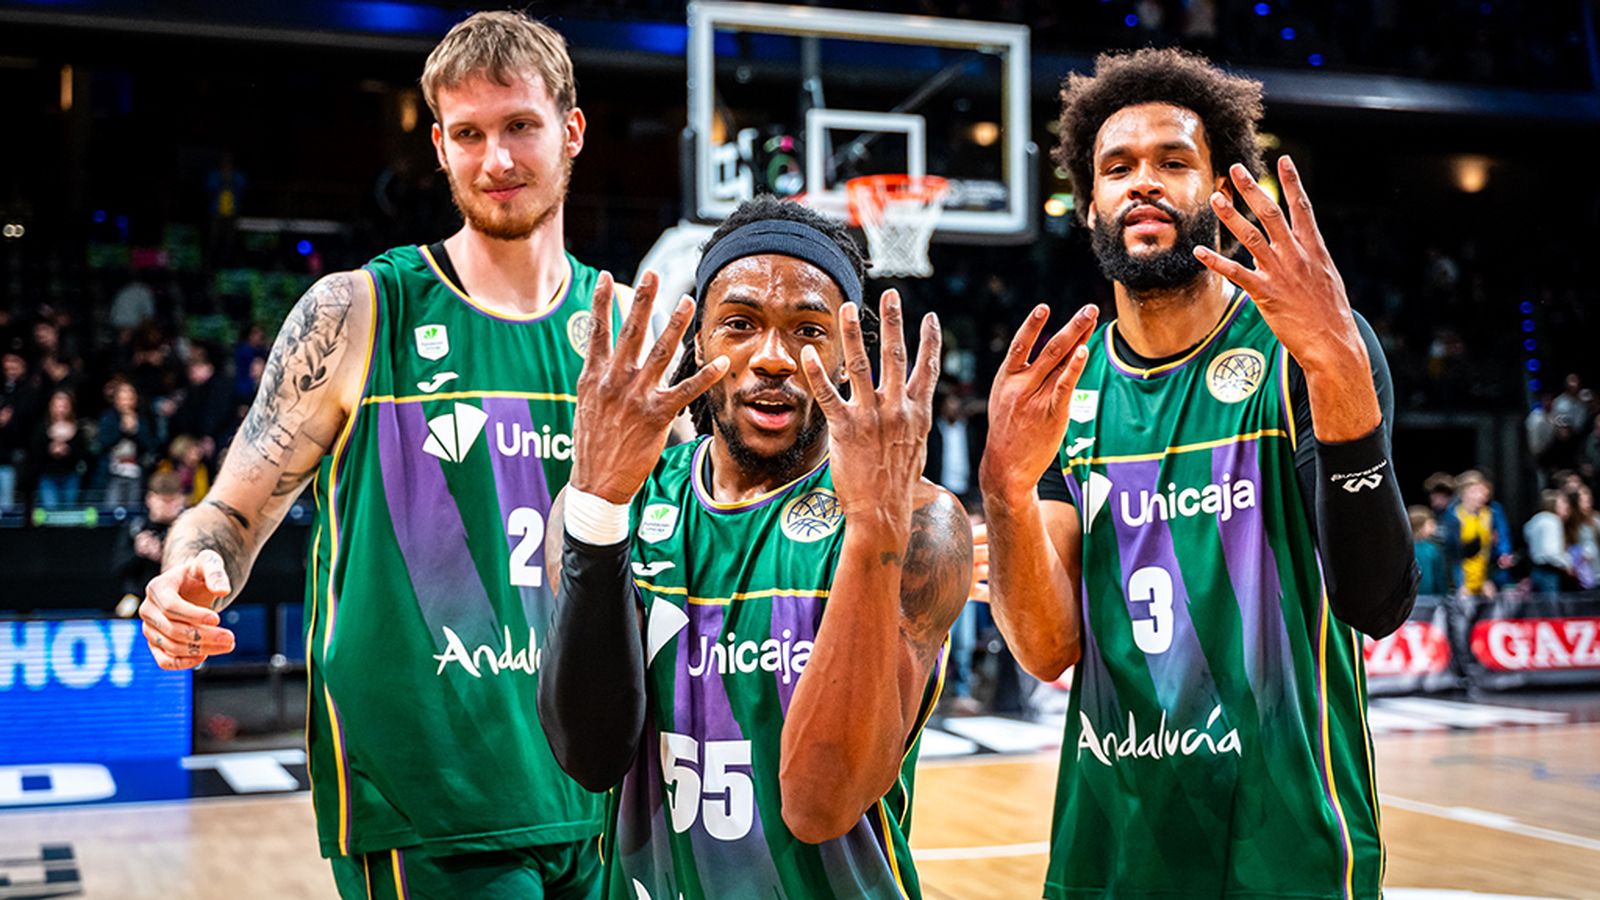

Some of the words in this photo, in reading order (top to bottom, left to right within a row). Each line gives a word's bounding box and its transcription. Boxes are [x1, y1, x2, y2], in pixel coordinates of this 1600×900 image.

[496, 422, 576, 462] Unic
[1120, 473, 1256, 527] Unicaja
[508, 507, 545, 587] 2
[1128, 566, 1174, 654] 3
[432, 624, 541, 678] Andal
[1488, 620, 1600, 669] GAZ
[1077, 704, 1242, 766] Andalucía
[660, 731, 754, 841] 55
